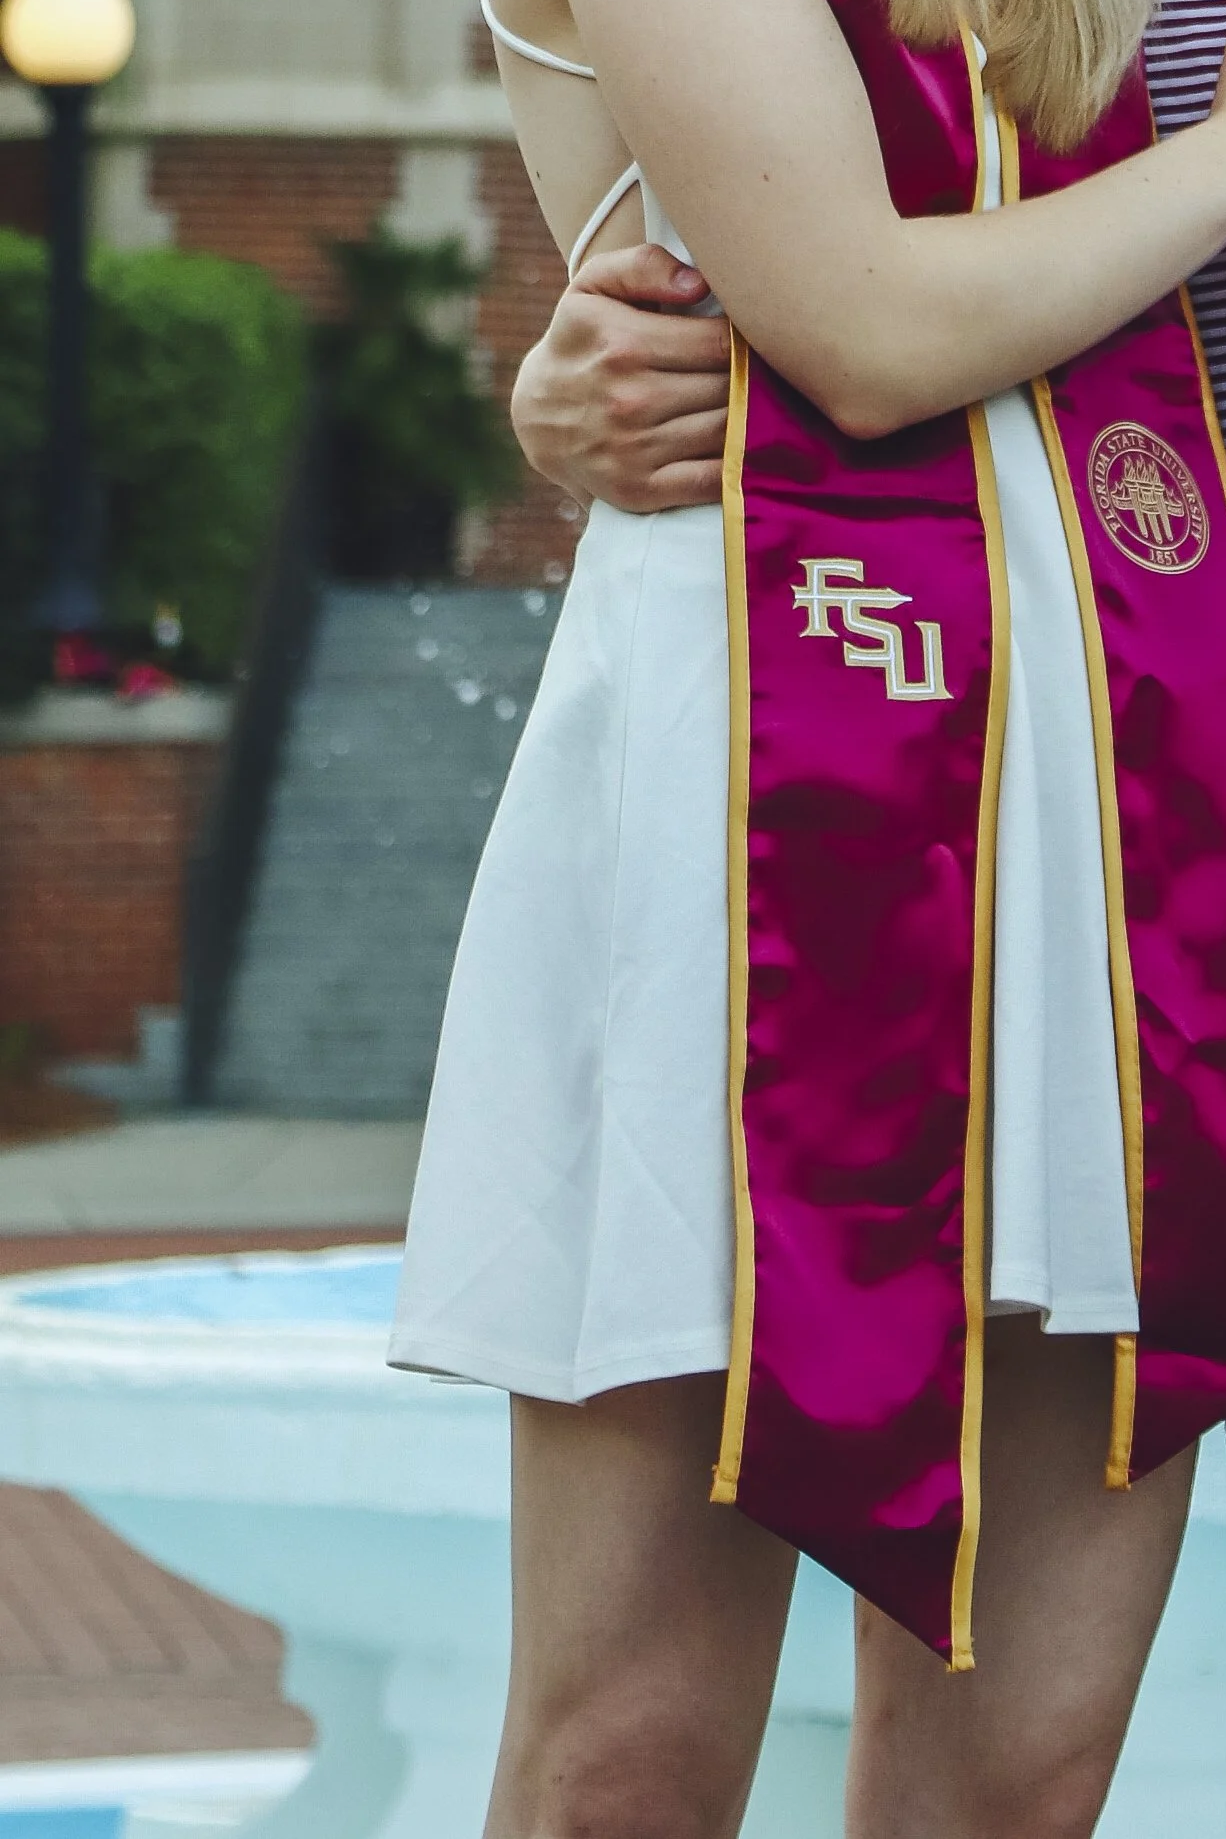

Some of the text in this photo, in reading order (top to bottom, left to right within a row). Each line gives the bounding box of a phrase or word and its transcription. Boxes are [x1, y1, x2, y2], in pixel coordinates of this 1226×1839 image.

[1093, 433, 1202, 543] FLORIDA STATE UNIVERSITY
[1149, 549, 1179, 565] 1851
[790, 558, 954, 700] FSU
